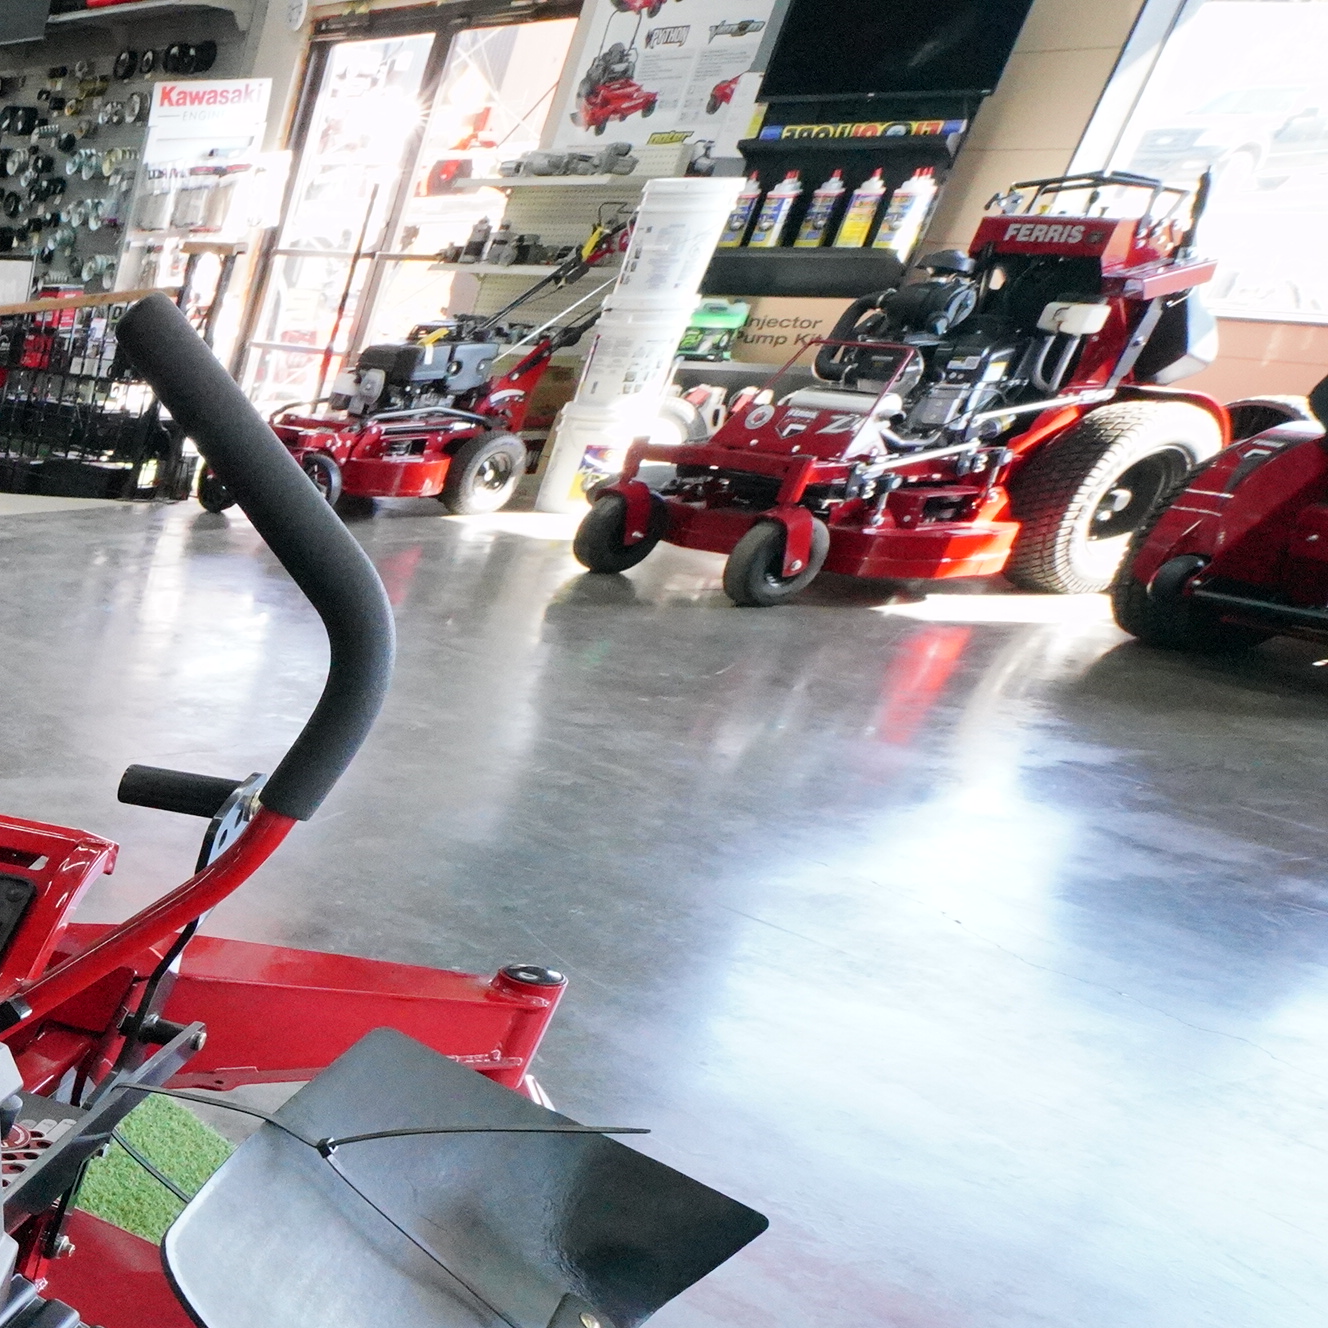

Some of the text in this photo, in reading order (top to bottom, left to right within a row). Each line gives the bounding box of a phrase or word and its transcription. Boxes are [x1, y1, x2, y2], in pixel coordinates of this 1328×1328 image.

[650, 25, 690, 48] PYTHON
[158, 83, 263, 107] Kawasaki
[1003, 223, 1086, 244] FERRIS
[744, 315, 823, 330] Injector
